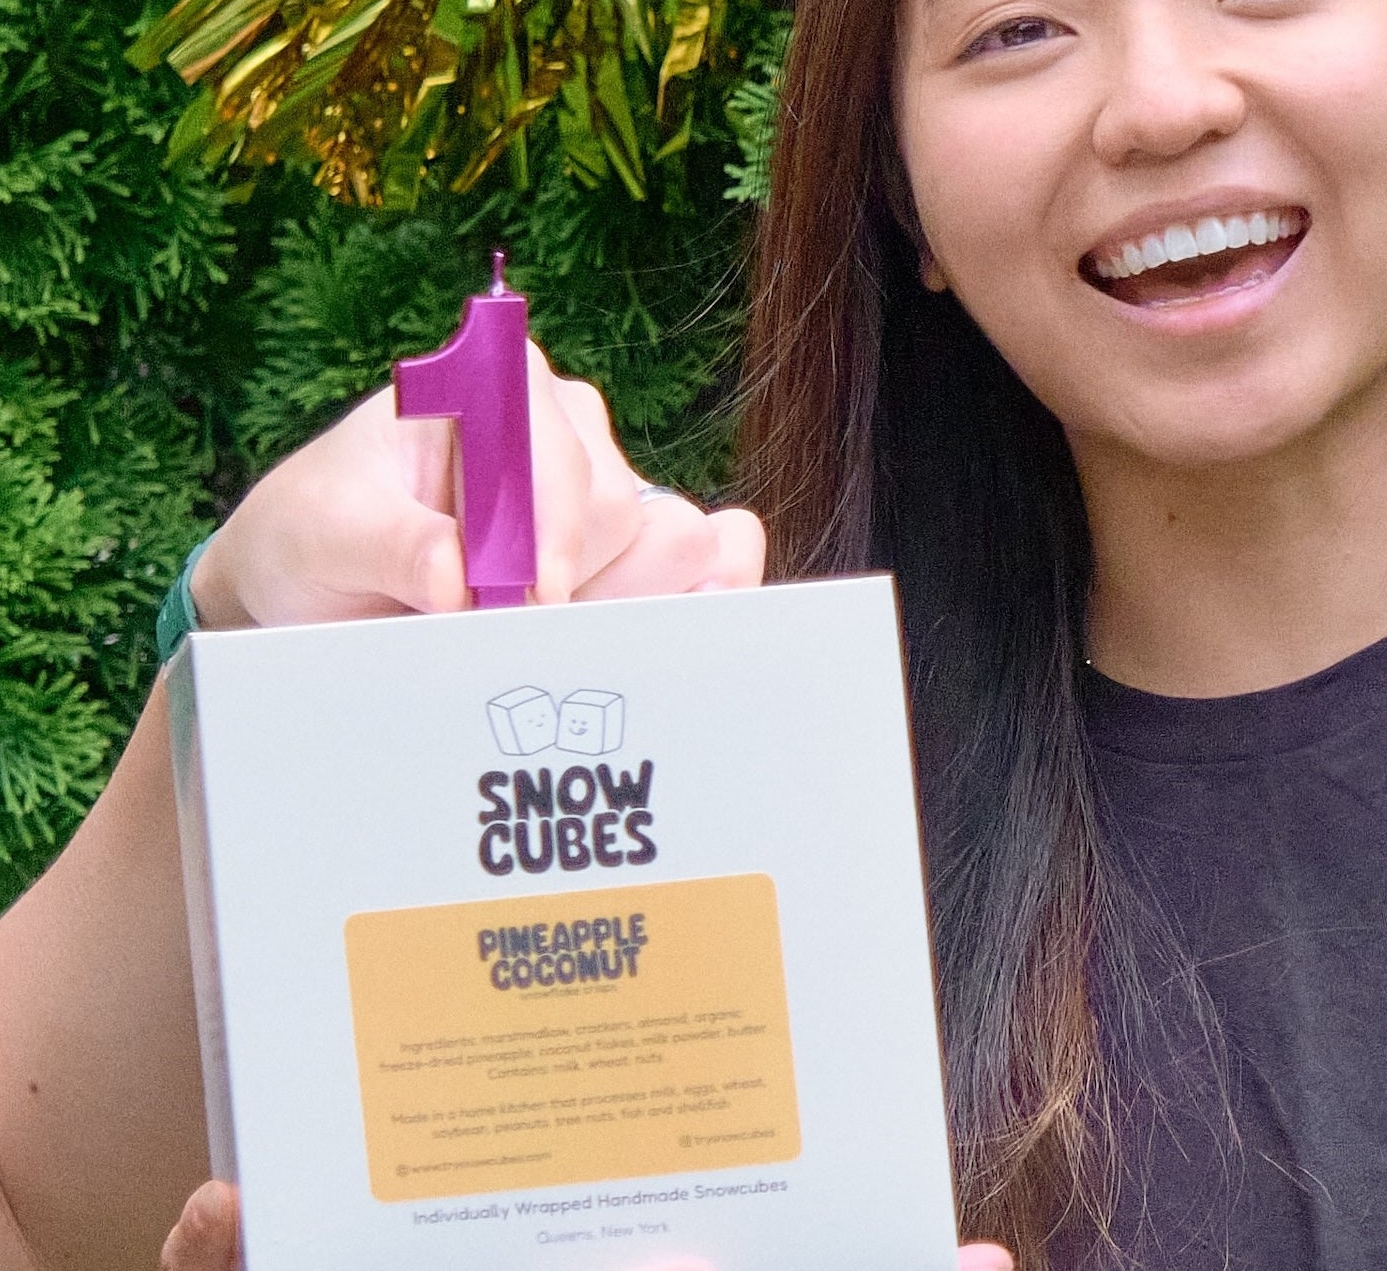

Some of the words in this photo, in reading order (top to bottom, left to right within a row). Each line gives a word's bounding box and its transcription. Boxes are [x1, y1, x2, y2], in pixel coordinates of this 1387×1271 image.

[478, 759, 654, 825] SNOW
[478, 810, 658, 876] CUBES
[478, 913, 648, 961] PINEAPPLE
[491, 946, 641, 991] COCONUT
[539, 1042, 591, 1057] coconut
[642, 1032, 668, 1045] milk
[727, 1024, 767, 1037] butter
[391, 1112, 429, 1125] Made
[432, 1110, 444, 1121] in
[448, 1111, 456, 1120] a
[459, 1105, 496, 1118] home
[499, 1100, 548, 1115] kitchen
[550, 1097, 577, 1109] that
[580, 1091, 647, 1107] processes
[555, 1114, 581, 1127] tree
[621, 1107, 643, 1119] fish
[647, 1104, 673, 1117] and
[413, 1204, 510, 1224] Individually
[515, 1195, 593, 1215] Wrapped
[597, 1188, 690, 1208] Handmade
[694, 1179, 789, 1200] Snowcubes
[601, 1225, 634, 1238] New
[638, 1222, 670, 1234] York
